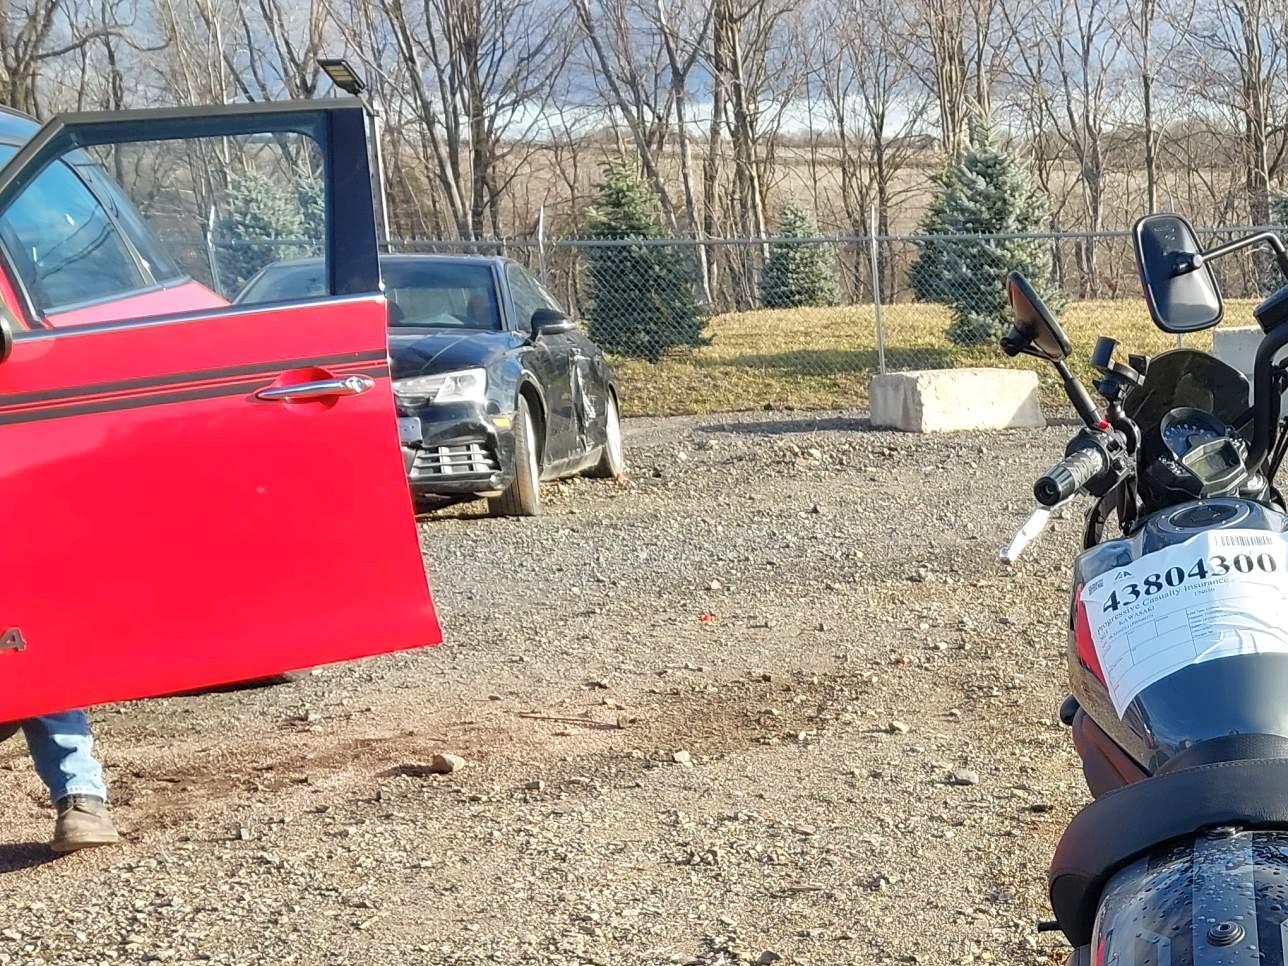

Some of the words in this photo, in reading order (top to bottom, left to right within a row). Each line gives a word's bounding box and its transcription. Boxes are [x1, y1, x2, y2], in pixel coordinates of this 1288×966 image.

[1103, 552, 1277, 613] 43804300
[1142, 588, 1182, 607] Casualty
[1184, 577, 1229, 593] Insurance
